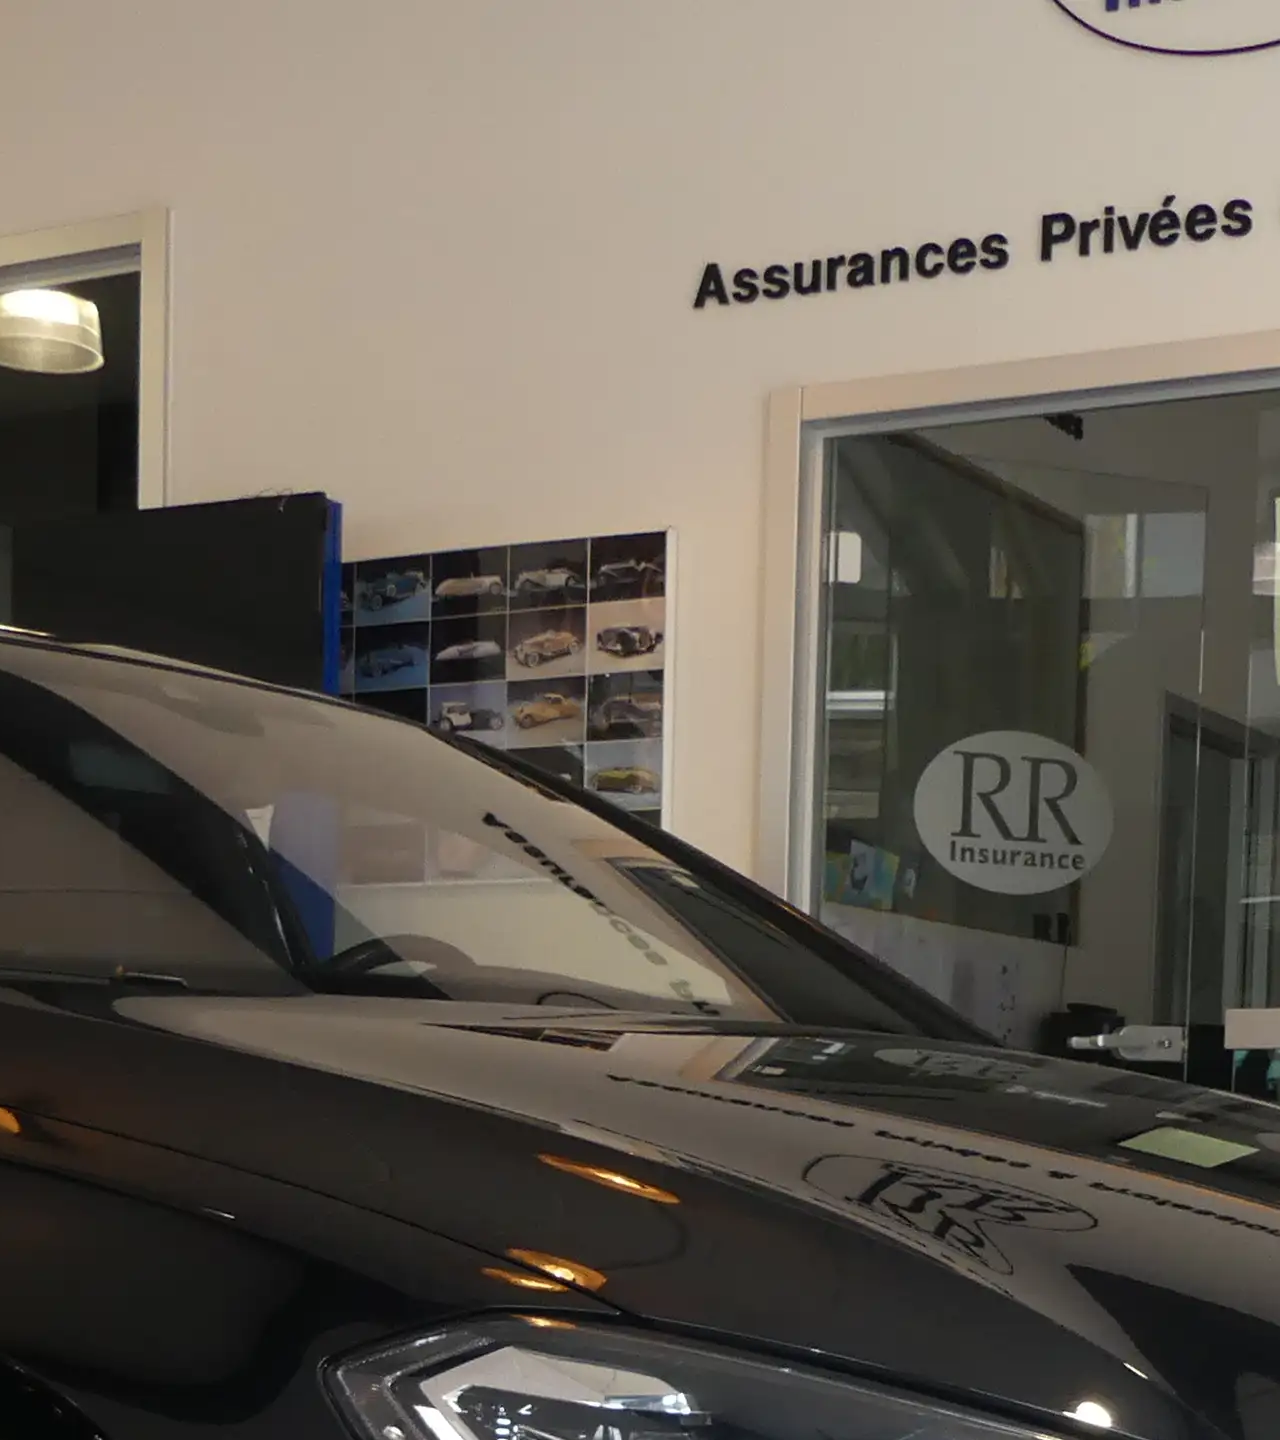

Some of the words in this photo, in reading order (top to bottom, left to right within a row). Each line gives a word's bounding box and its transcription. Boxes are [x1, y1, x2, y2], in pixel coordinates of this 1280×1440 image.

[693, 232, 1011, 310] Assurances
[1040, 194, 1254, 263] Privées
[950, 750, 1084, 846] RR
[949, 839, 1086, 871] Insurance
